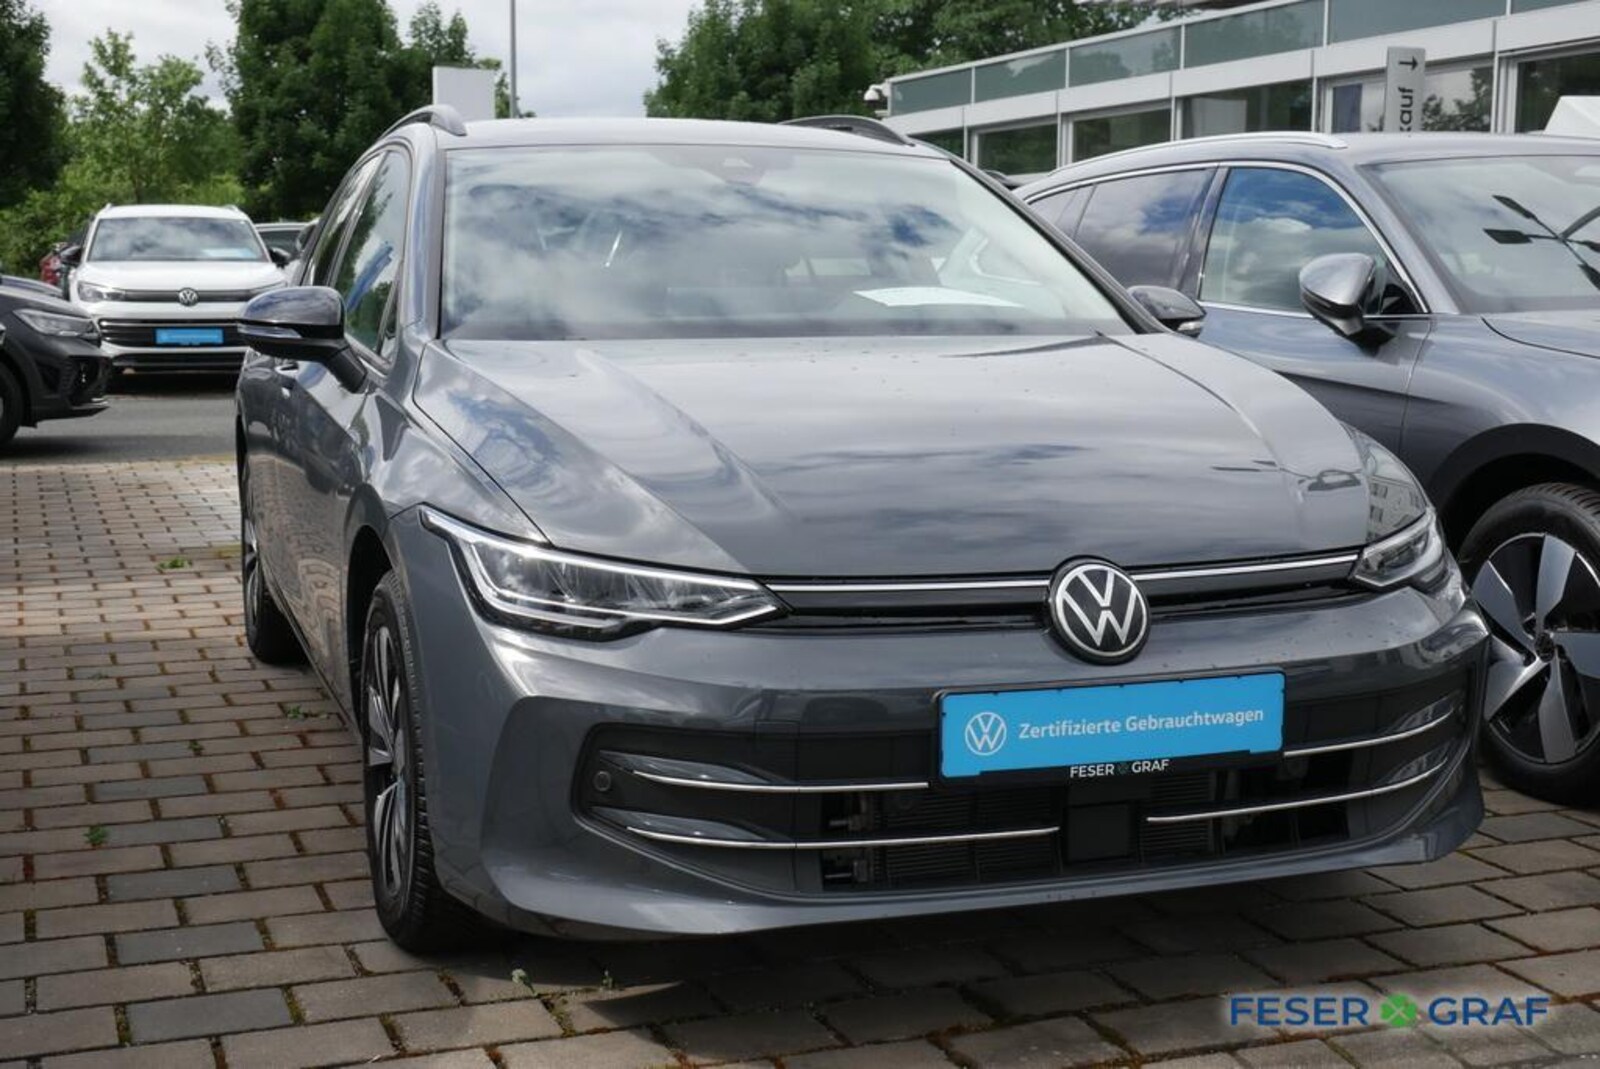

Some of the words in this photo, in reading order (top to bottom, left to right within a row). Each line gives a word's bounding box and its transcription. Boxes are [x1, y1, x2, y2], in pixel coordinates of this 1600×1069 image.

[1057, 564, 1145, 657] VW
[1018, 718, 1122, 740] Zertifizierte
[1125, 707, 1265, 734] Gebrauchtwagen
[1069, 764, 1116, 780] FESER
[1131, 759, 1170, 774] GRAF
